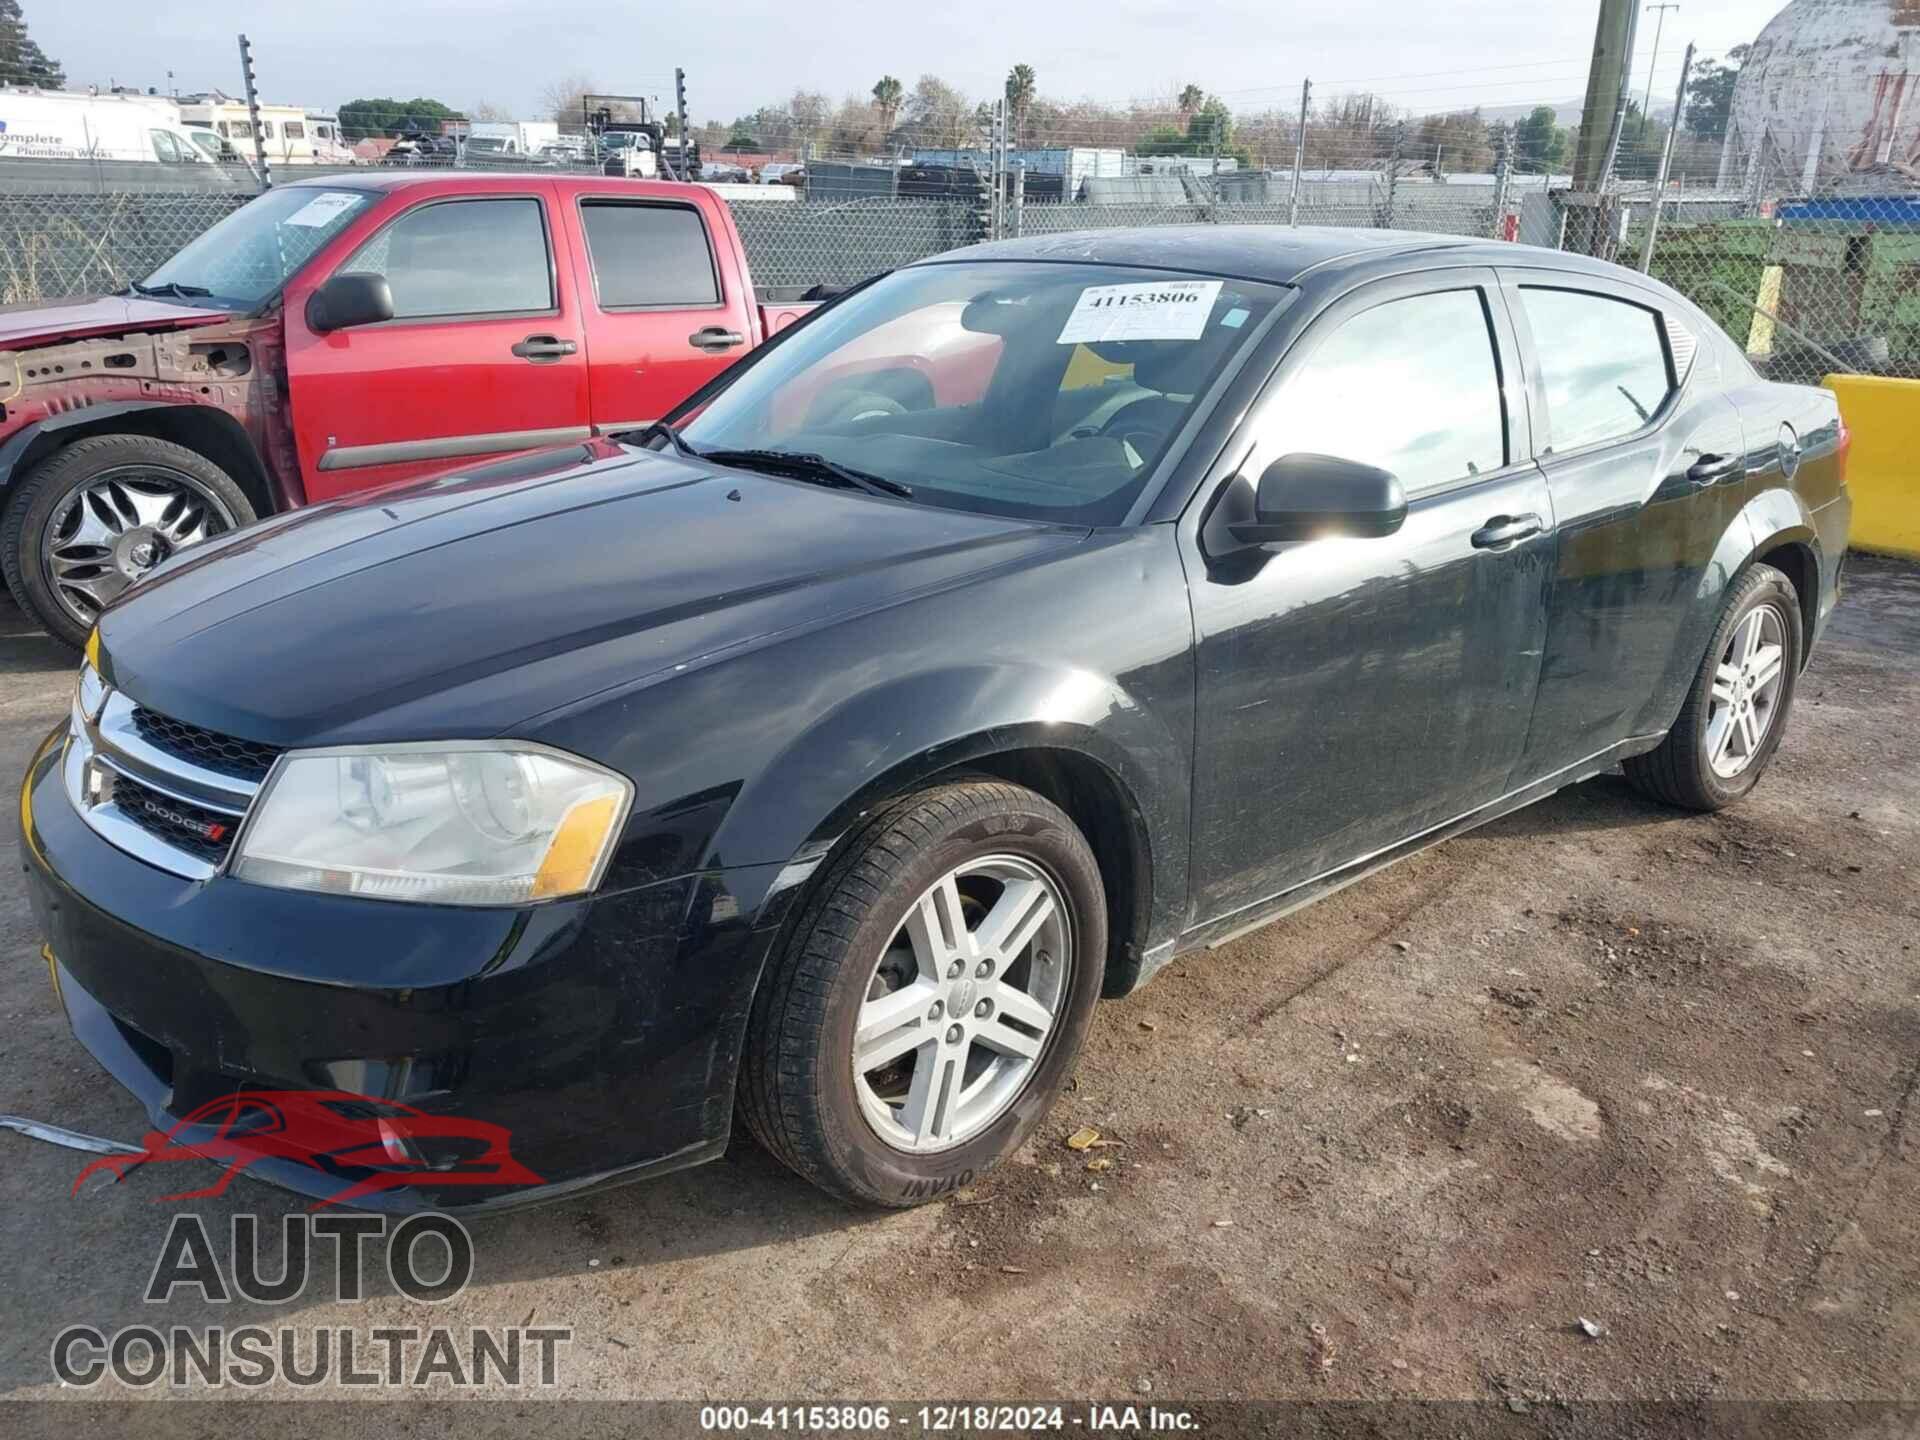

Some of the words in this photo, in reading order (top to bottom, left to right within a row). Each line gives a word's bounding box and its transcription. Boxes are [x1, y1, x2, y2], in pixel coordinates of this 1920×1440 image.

[0, 133, 62, 144] omplete
[17, 146, 74, 158] Plumbing
[1089, 293, 1198, 308] 41153806
[145, 801, 212, 835] DODGE
